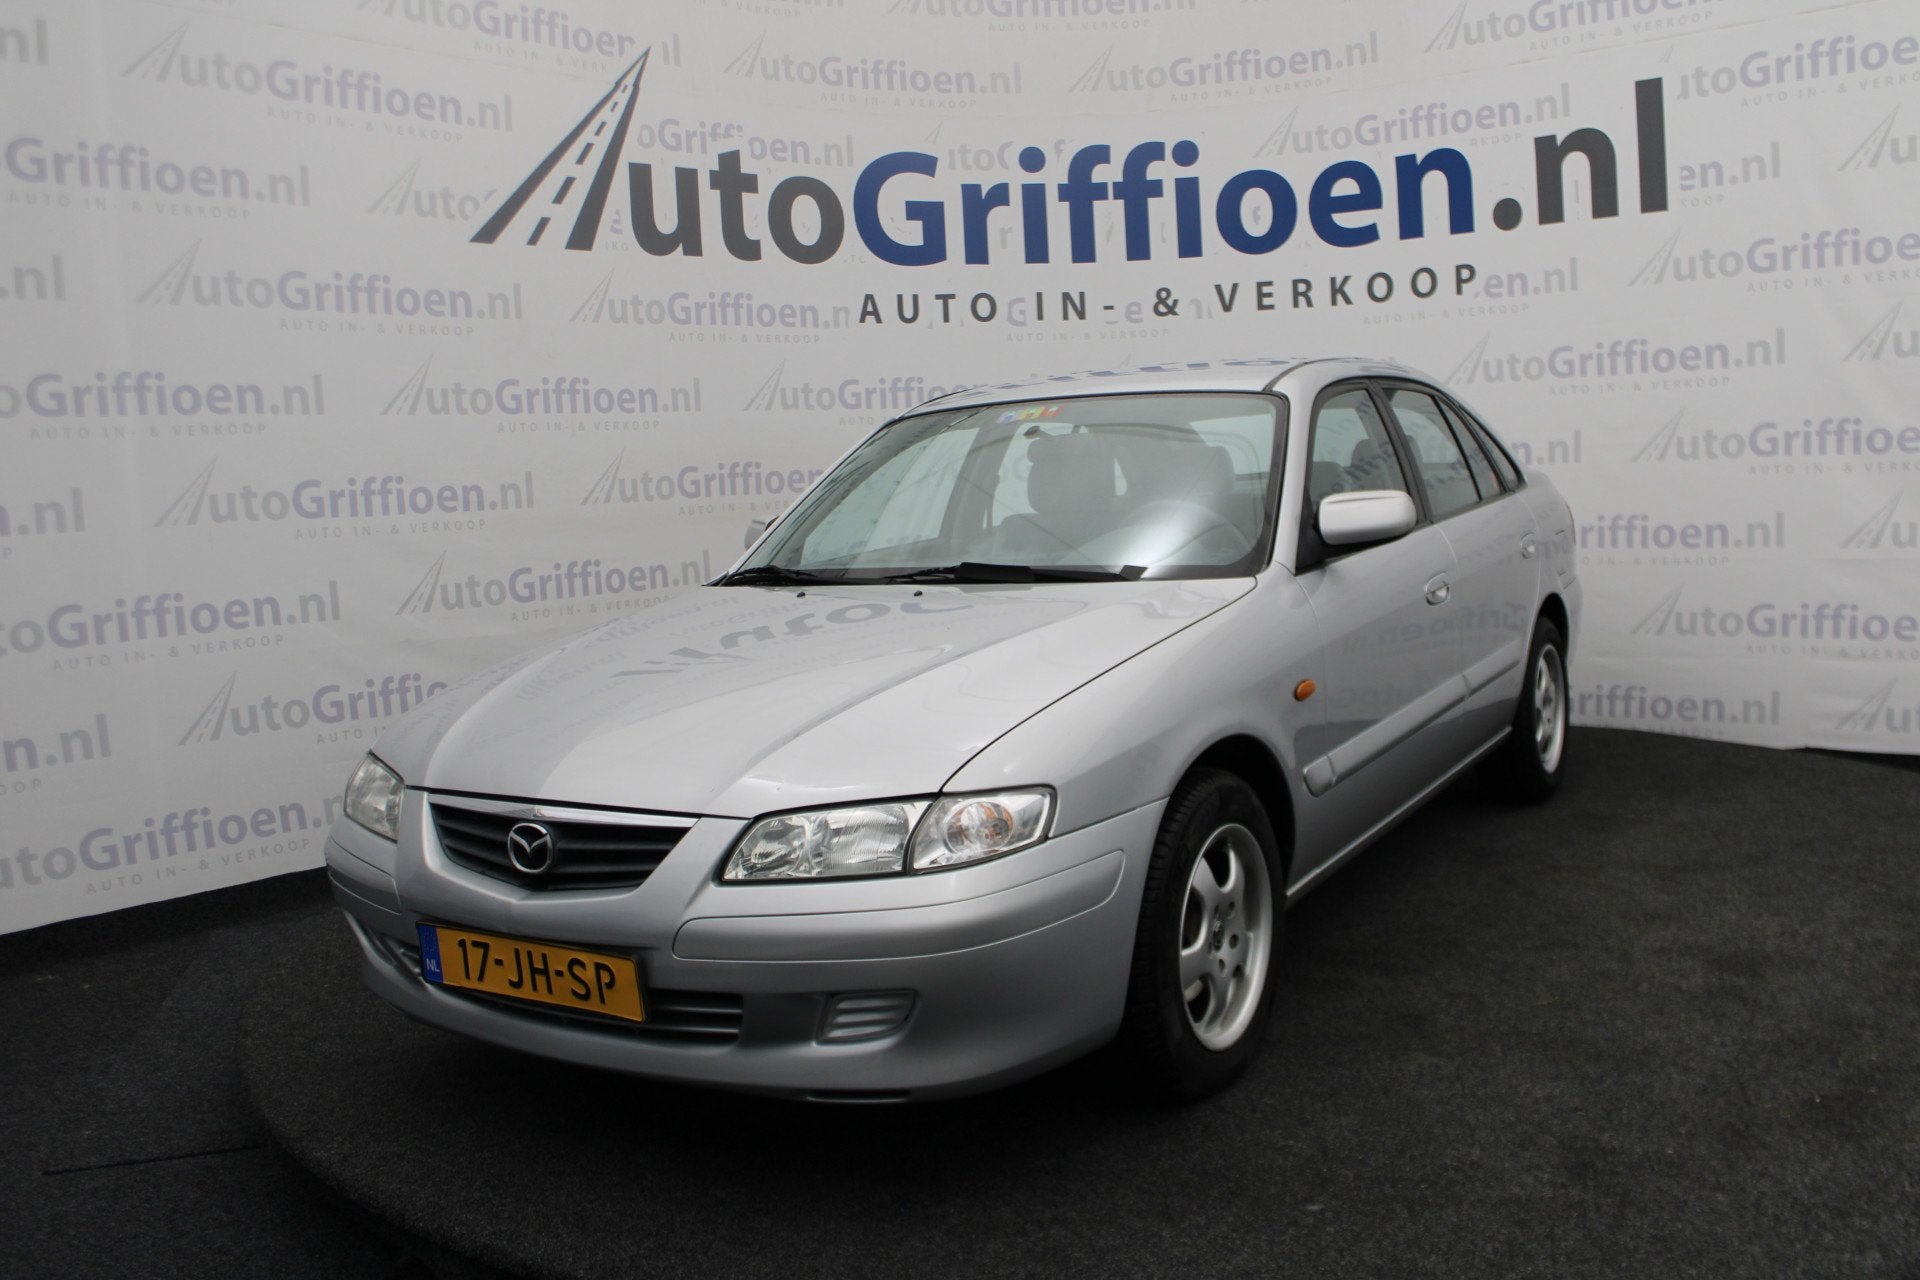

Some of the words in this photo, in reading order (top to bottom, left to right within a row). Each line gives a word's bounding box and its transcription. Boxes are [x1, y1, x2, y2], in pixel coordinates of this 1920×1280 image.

[987, 22, 1026, 32] AUTO
[474, 41, 514, 57] AUTO
[1530, 34, 1570, 50] AUTO
[722, 29, 1022, 94] AutoGriffioen.nl
[1067, 31, 1378, 94] AutoGriffioen.nl
[120, 18, 512, 132] AutoGriffioen.nl
[820, 92, 856, 103] AUTO
[1170, 91, 1208, 102] AUTO
[1741, 90, 1787, 107] AUTO
[267, 105, 315, 124] AUTO
[1252, 82, 1571, 159] AutoGriffioen.nl
[469, 46, 1669, 265] AutoGriffioen.nl
[8, 190, 71, 208] AUTO
[134, 238, 523, 320] AutoGriffioen.nl
[1746, 279, 1794, 294] AUTO
[858, 292, 998, 325] AUTO
[1152, 286, 1180, 318] &
[1213, 262, 1478, 314] VERKOOP
[280, 318, 328, 333] AUTO
[1362, 314, 1402, 326] AUTO
[668, 332, 704, 344] AUTO
[1006, 331, 1045, 343] AUTO
[379, 352, 702, 416] AutoGriffioen.nl
[1550, 385, 1591, 397] AUTO
[497, 422, 538, 434] AUTO
[838, 416, 875, 427] AUTO
[29, 427, 91, 441] AUTO
[1749, 463, 1795, 475] AUTO
[153, 456, 534, 528] AutoGriffioen.nl
[678, 505, 714, 517] AUTO
[295, 525, 342, 540] AUTO
[0, 579, 341, 655] oGriffioen.nl
[511, 607, 551, 623] AUTO
[1745, 644, 1792, 656] AUTO
[54, 655, 111, 672] AUTO
[316, 729, 363, 745] AUTO
[84, 873, 143, 896] AUTO
[425, 957, 441, 974] NL
[457, 937, 617, 1006] 17-JH-SP
